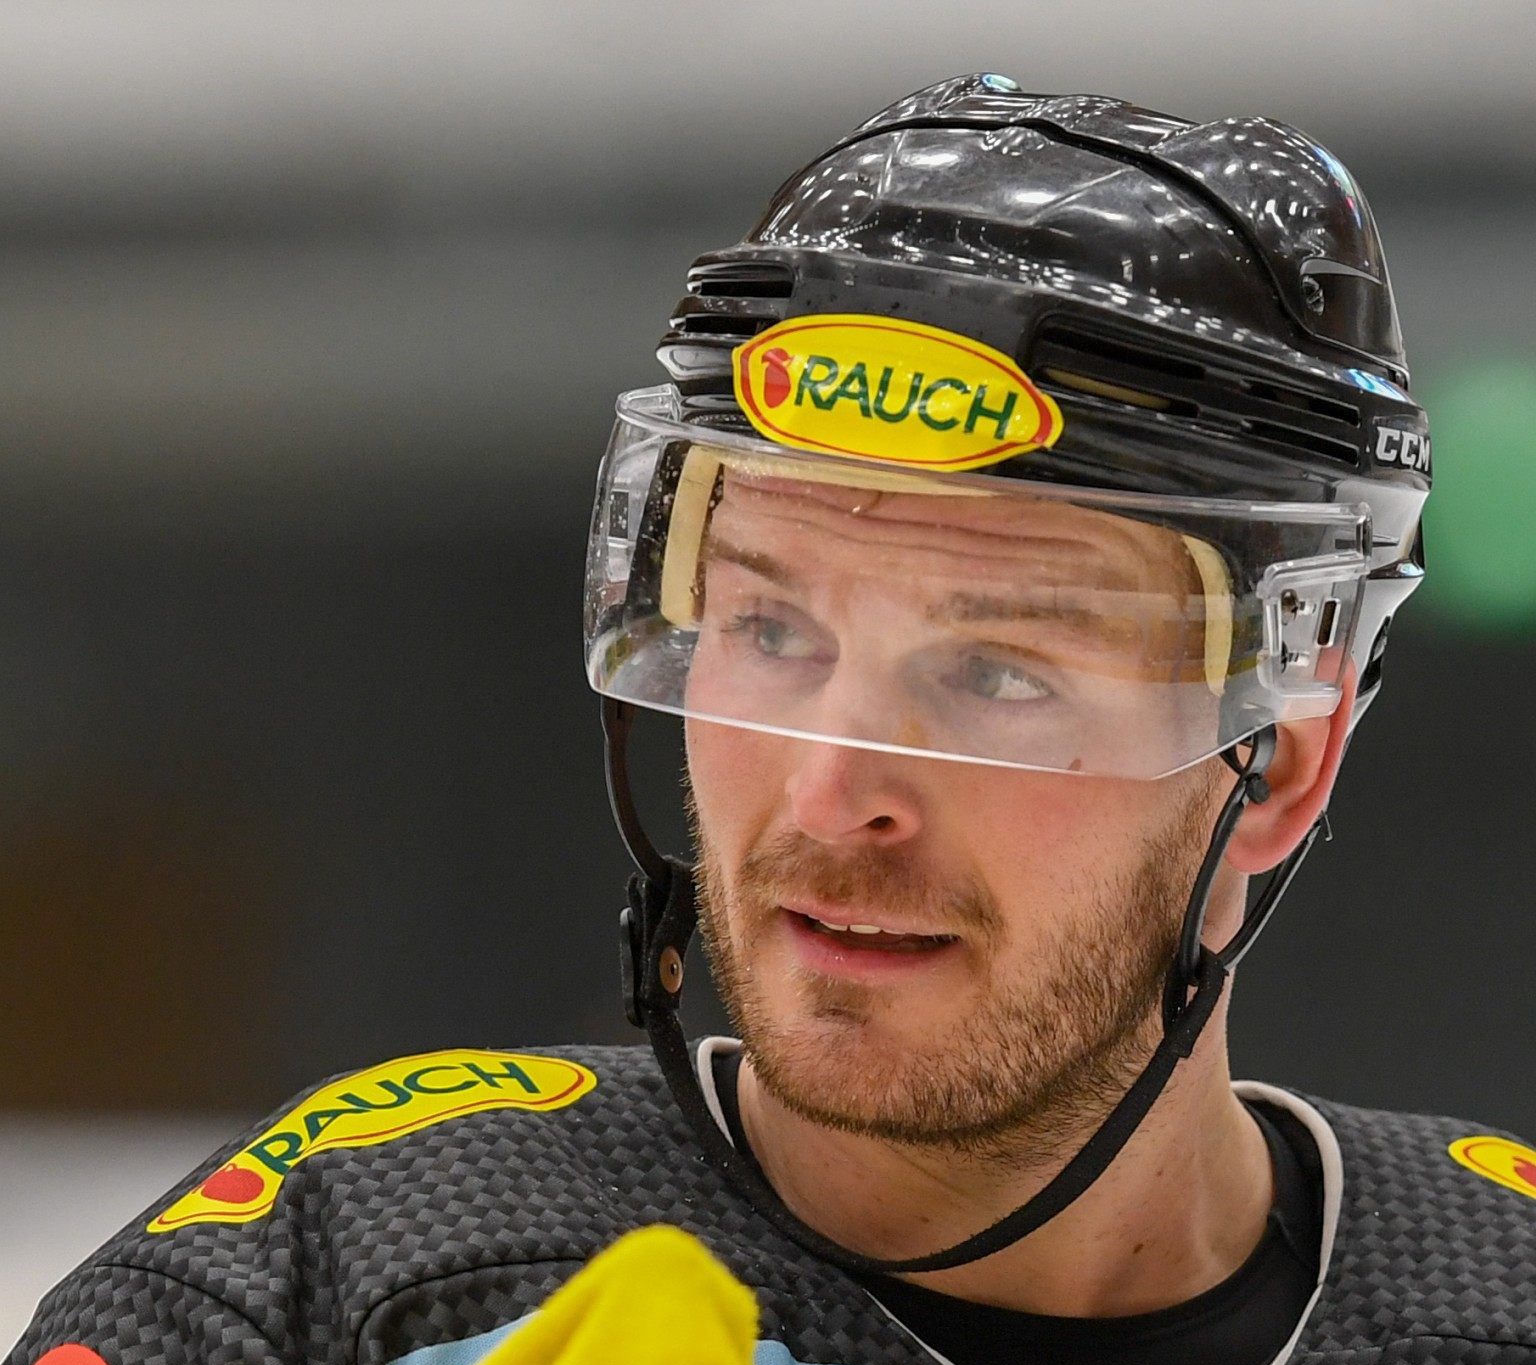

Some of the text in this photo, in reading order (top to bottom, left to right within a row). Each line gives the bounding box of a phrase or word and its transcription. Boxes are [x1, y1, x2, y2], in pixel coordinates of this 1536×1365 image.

[794, 354, 1019, 440] RAUCH
[1376, 426, 1430, 472] CCM
[247, 1060, 540, 1175] RAUCH
